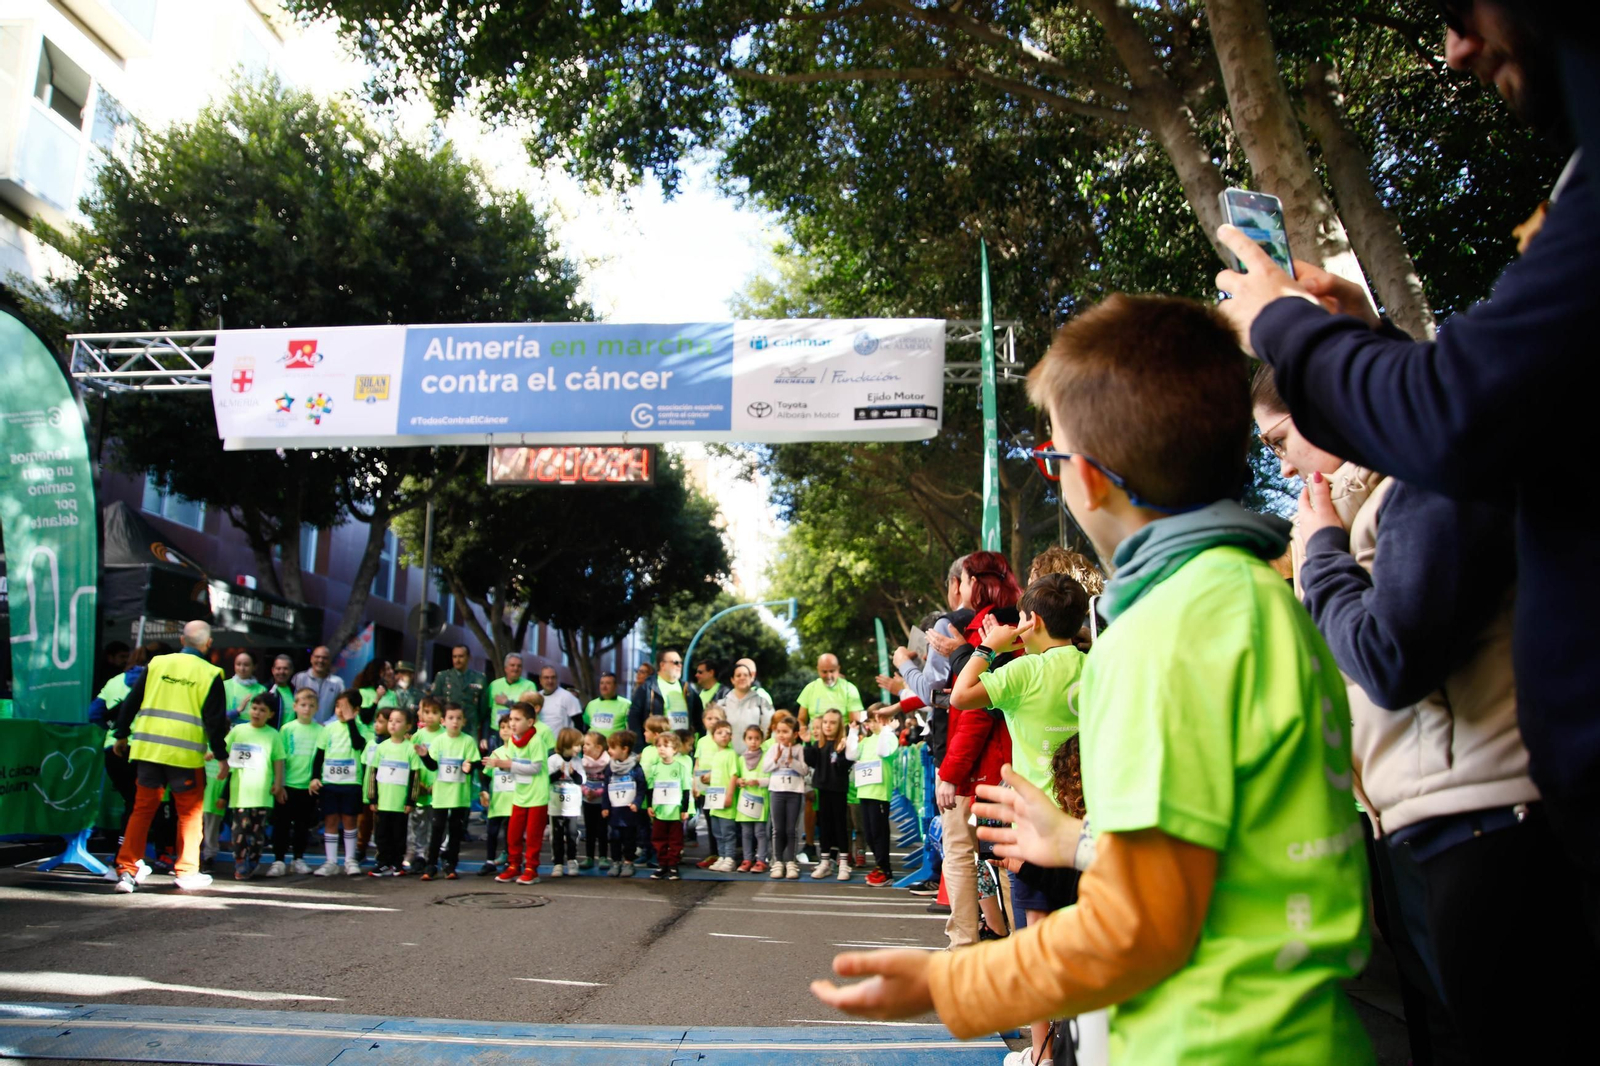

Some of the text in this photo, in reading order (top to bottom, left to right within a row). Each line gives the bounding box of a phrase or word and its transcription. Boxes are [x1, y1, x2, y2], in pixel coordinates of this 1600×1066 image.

[423, 334, 714, 361] Almería en marcha
[420, 366, 674, 394] contra el cáncer
[831, 369, 901, 384] Fundación
[867, 391, 925, 403] Ejido Motor
[777, 401, 808, 410] Toyota
[777, 410, 840, 419] Alborán Motor
[238, 751, 252, 760] 29
[329, 766, 350, 775] 886
[389, 767, 396, 775] 7
[445, 766, 459, 774] 87
[861, 768, 873, 777] 32
[780, 776, 792, 784] 11
[559, 794, 571, 802] 98
[615, 790, 627, 798] 17
[743, 799, 754, 809] 31
